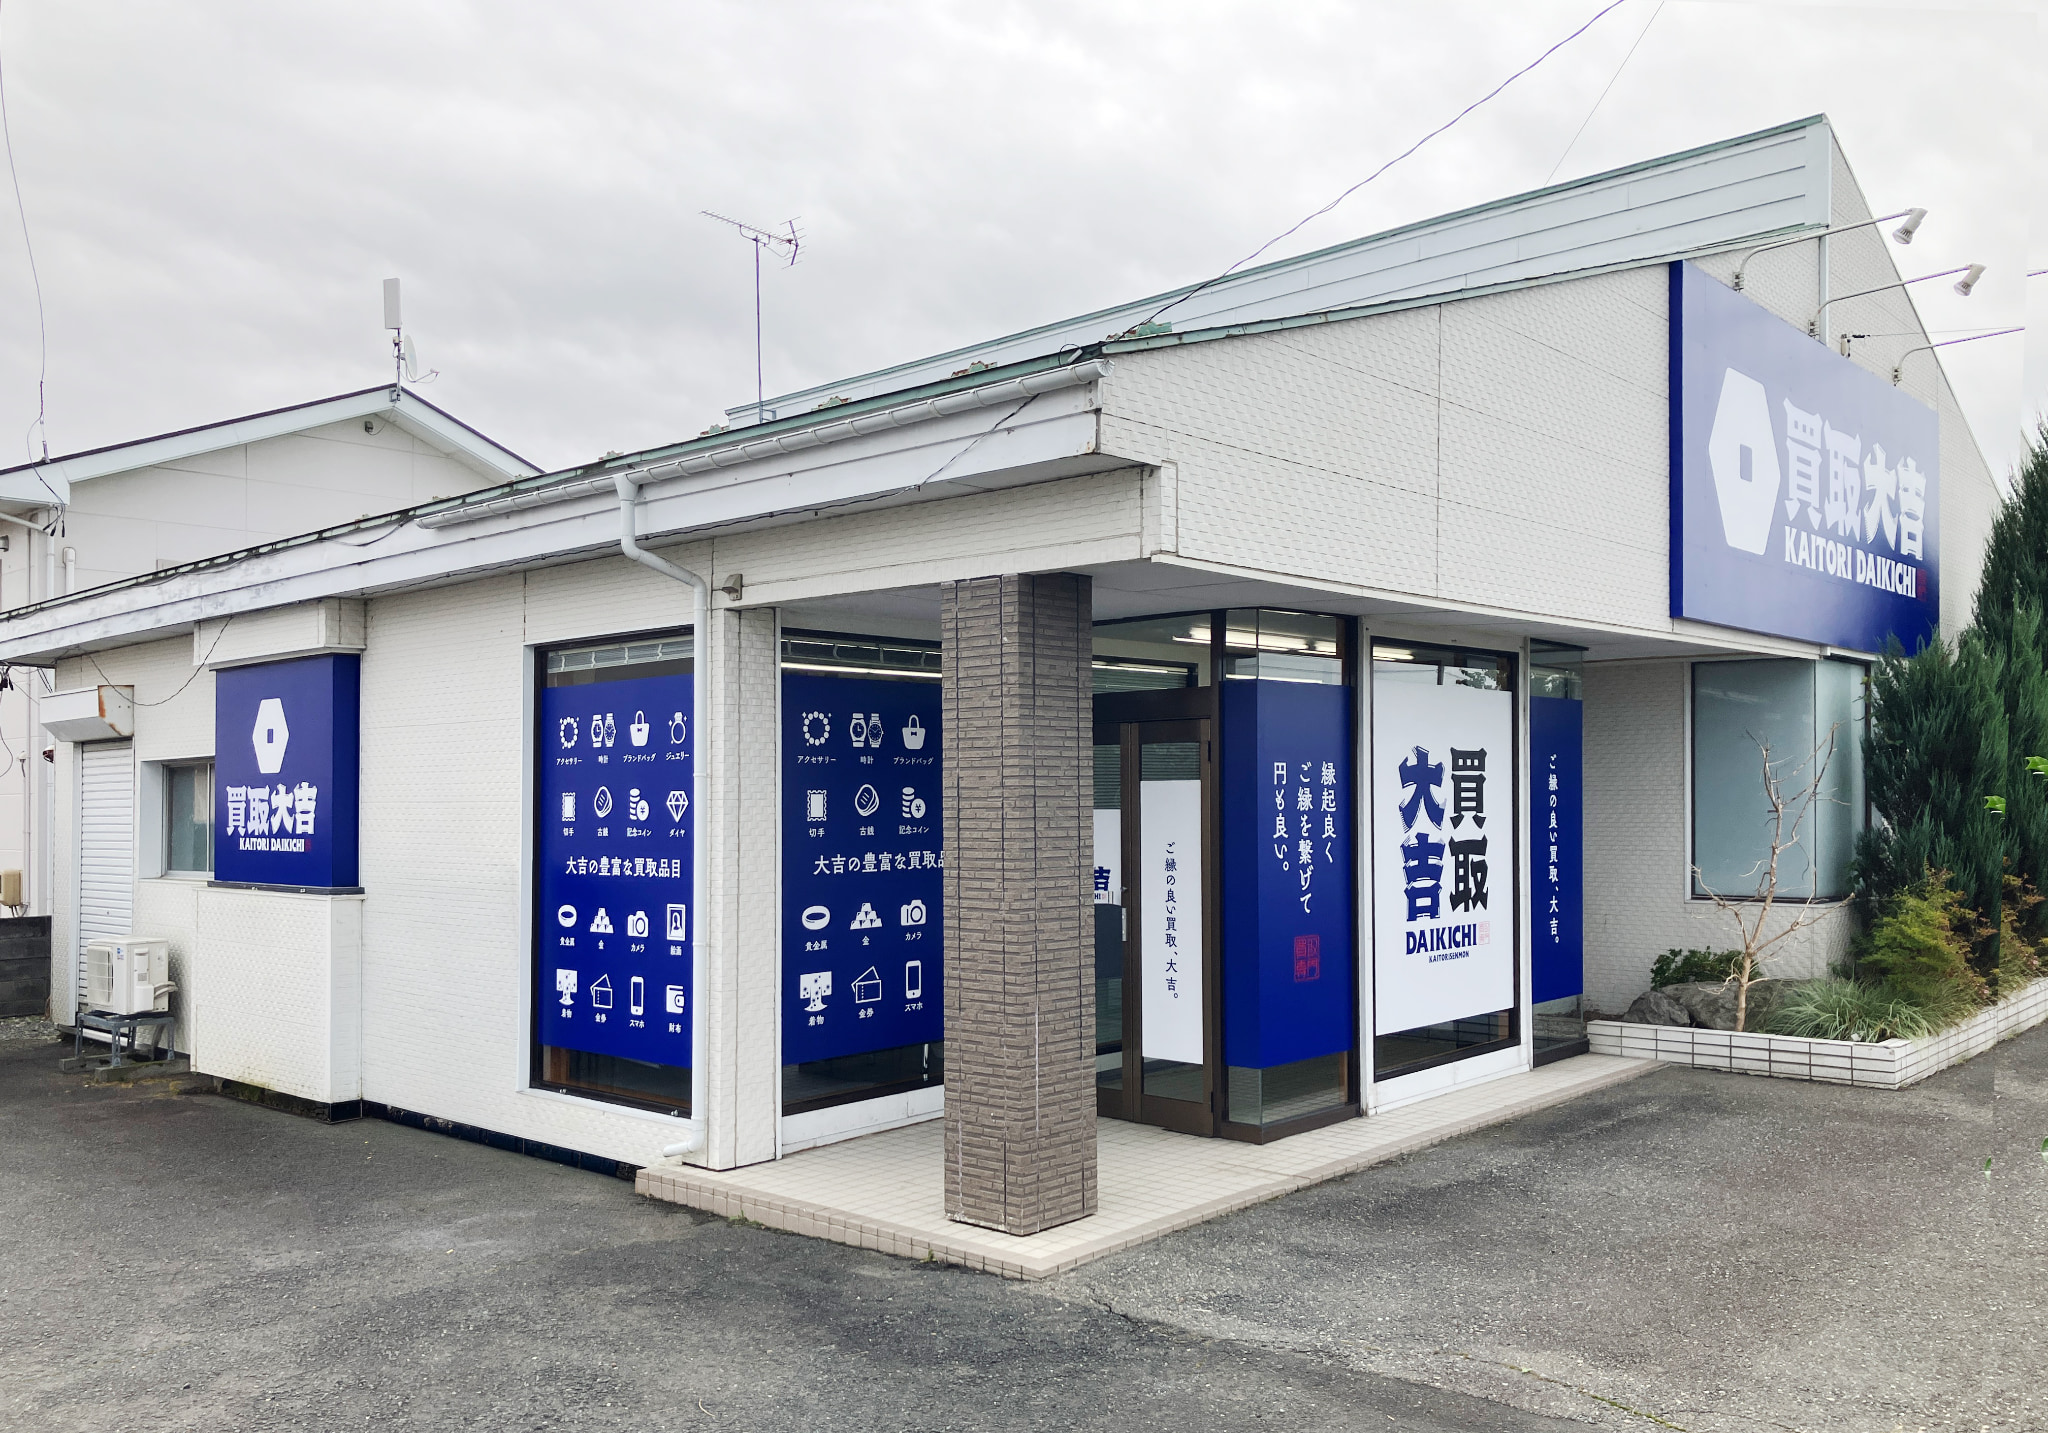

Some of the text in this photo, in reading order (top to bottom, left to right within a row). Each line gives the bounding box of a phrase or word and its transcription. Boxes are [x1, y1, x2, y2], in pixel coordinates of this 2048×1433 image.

[1783, 397, 1927, 561] 買取大吉
[1784, 525, 1853, 580] KAITORI
[1856, 549, 1917, 598] DAIKICHI
[665, 751, 690, 761] ジュエリー
[797, 755, 837, 764] アクセサリー
[860, 755, 874, 765] 時計
[893, 756, 935, 765] ブランドバッグ
[226, 781, 318, 836] 買取大吉
[1320, 760, 1337, 864] 縁起良く
[1273, 761, 1290, 872] 円も良い。
[669, 828, 686, 838] ダイヤ
[808, 827, 825, 838] 切手
[859, 825, 875, 836] 古銭
[898, 824, 930, 835] 記念コイン
[1398, 745, 1447, 922] 大吉
[1449, 746, 1489, 913] 買取
[1296, 761, 1314, 914] ご縁を繋げて
[239, 837, 270, 851] KAITORI
[271, 838, 305, 852] DAIKICHI
[1548, 754, 1560, 944] ご縁の良い買取、大吉。
[565, 855, 681, 879] 大吉の豊富な買取品目
[1165, 841, 1178, 999] ご縁の良い買取、大吉。
[861, 935, 870, 946] 金
[905, 931, 922, 941] カメラ
[1405, 923, 1477, 955] DAIKICHI
[630, 943, 645, 953] カメラ
[805, 939, 828, 952] 貴金属
[904, 1001, 924, 1012] スマホ
[629, 1019, 645, 1029] スマホ
[808, 1014, 825, 1027] 着物
